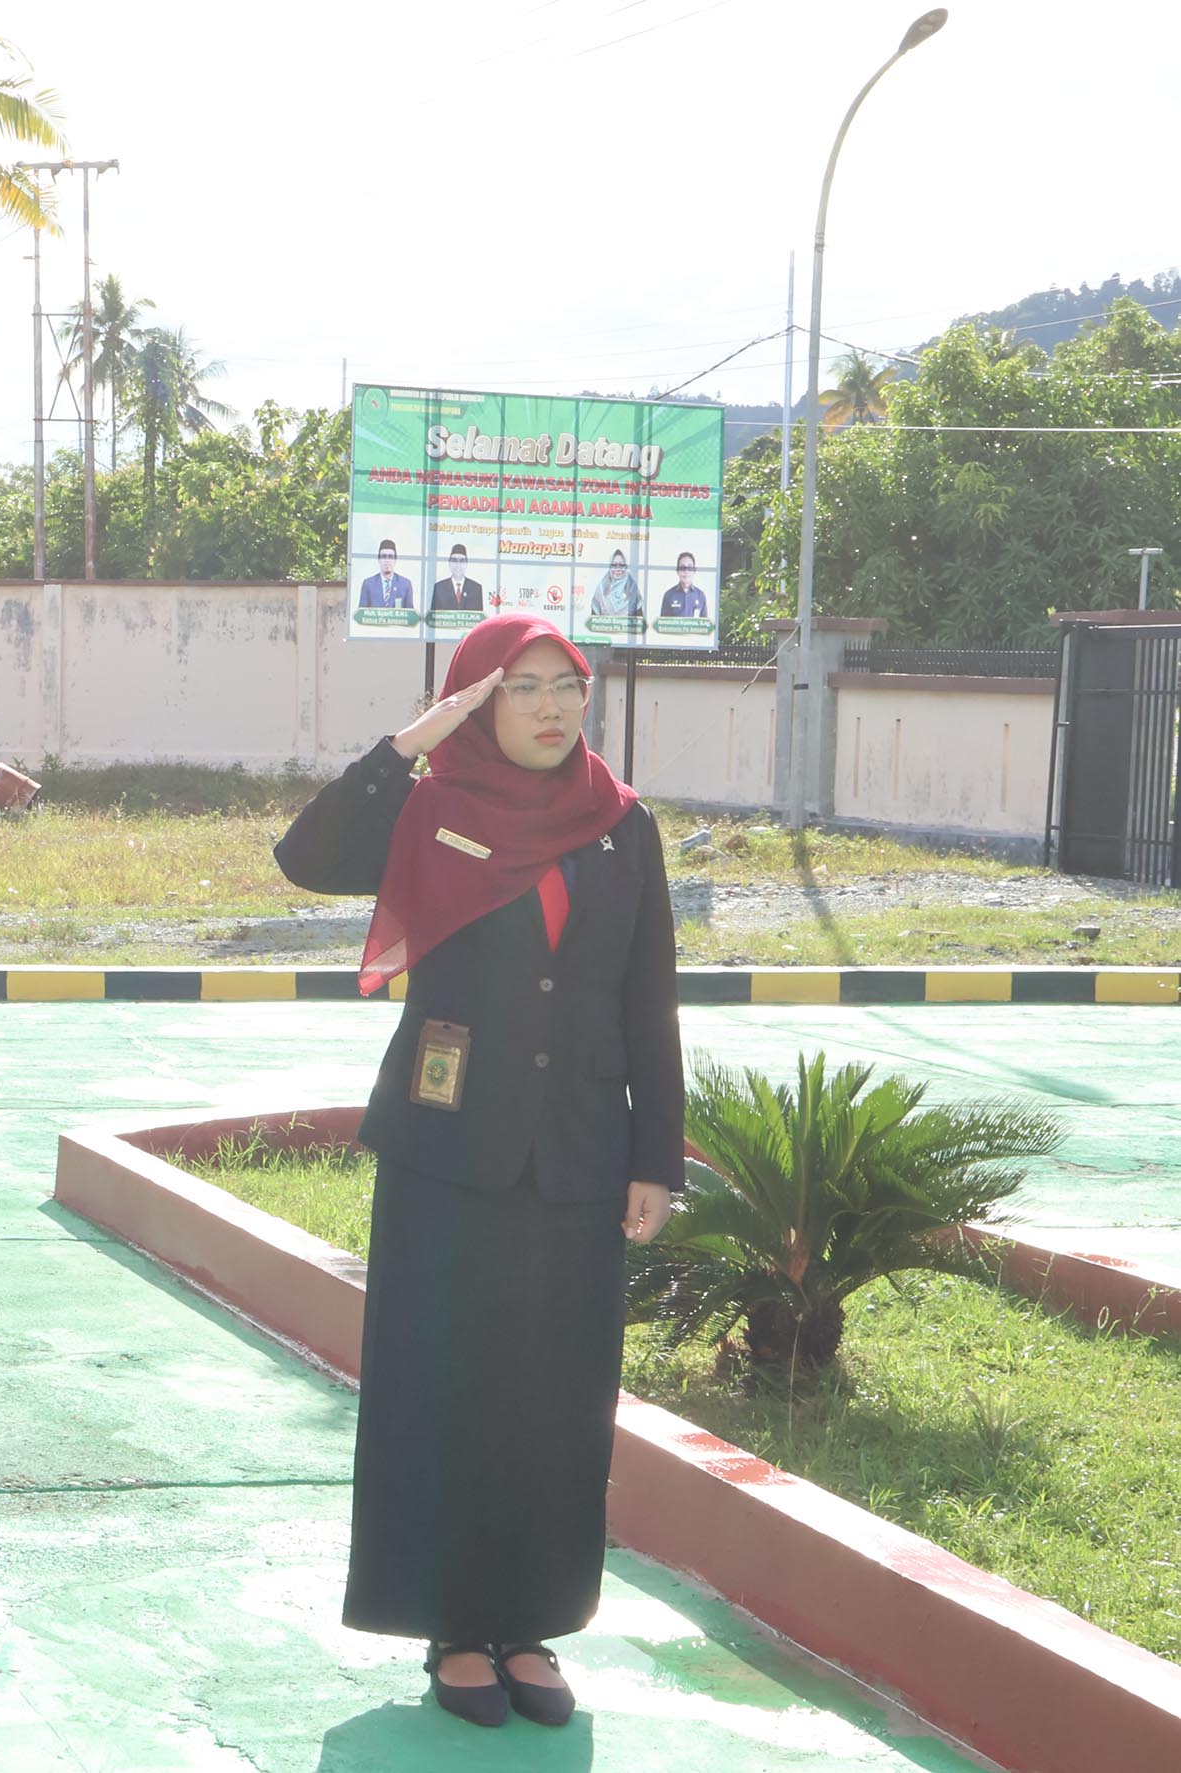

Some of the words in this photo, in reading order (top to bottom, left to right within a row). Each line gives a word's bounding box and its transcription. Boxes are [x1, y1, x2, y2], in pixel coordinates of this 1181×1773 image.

[426, 425, 551, 466] Selamat
[555, 432, 661, 478] Datang
[369, 467, 412, 484] ANDA
[416, 470, 499, 488] MEMASUKI
[501, 474, 576, 492] KAWASAN
[580, 478, 621, 494] ZONA
[625, 480, 710, 499] INTEGRITAS
[427, 495, 525, 514] PENGADILAN
[529, 499, 585, 516] AGAMA
[589, 502, 653, 519] AMPANA
[498, 540, 575, 558] MantapLEA
